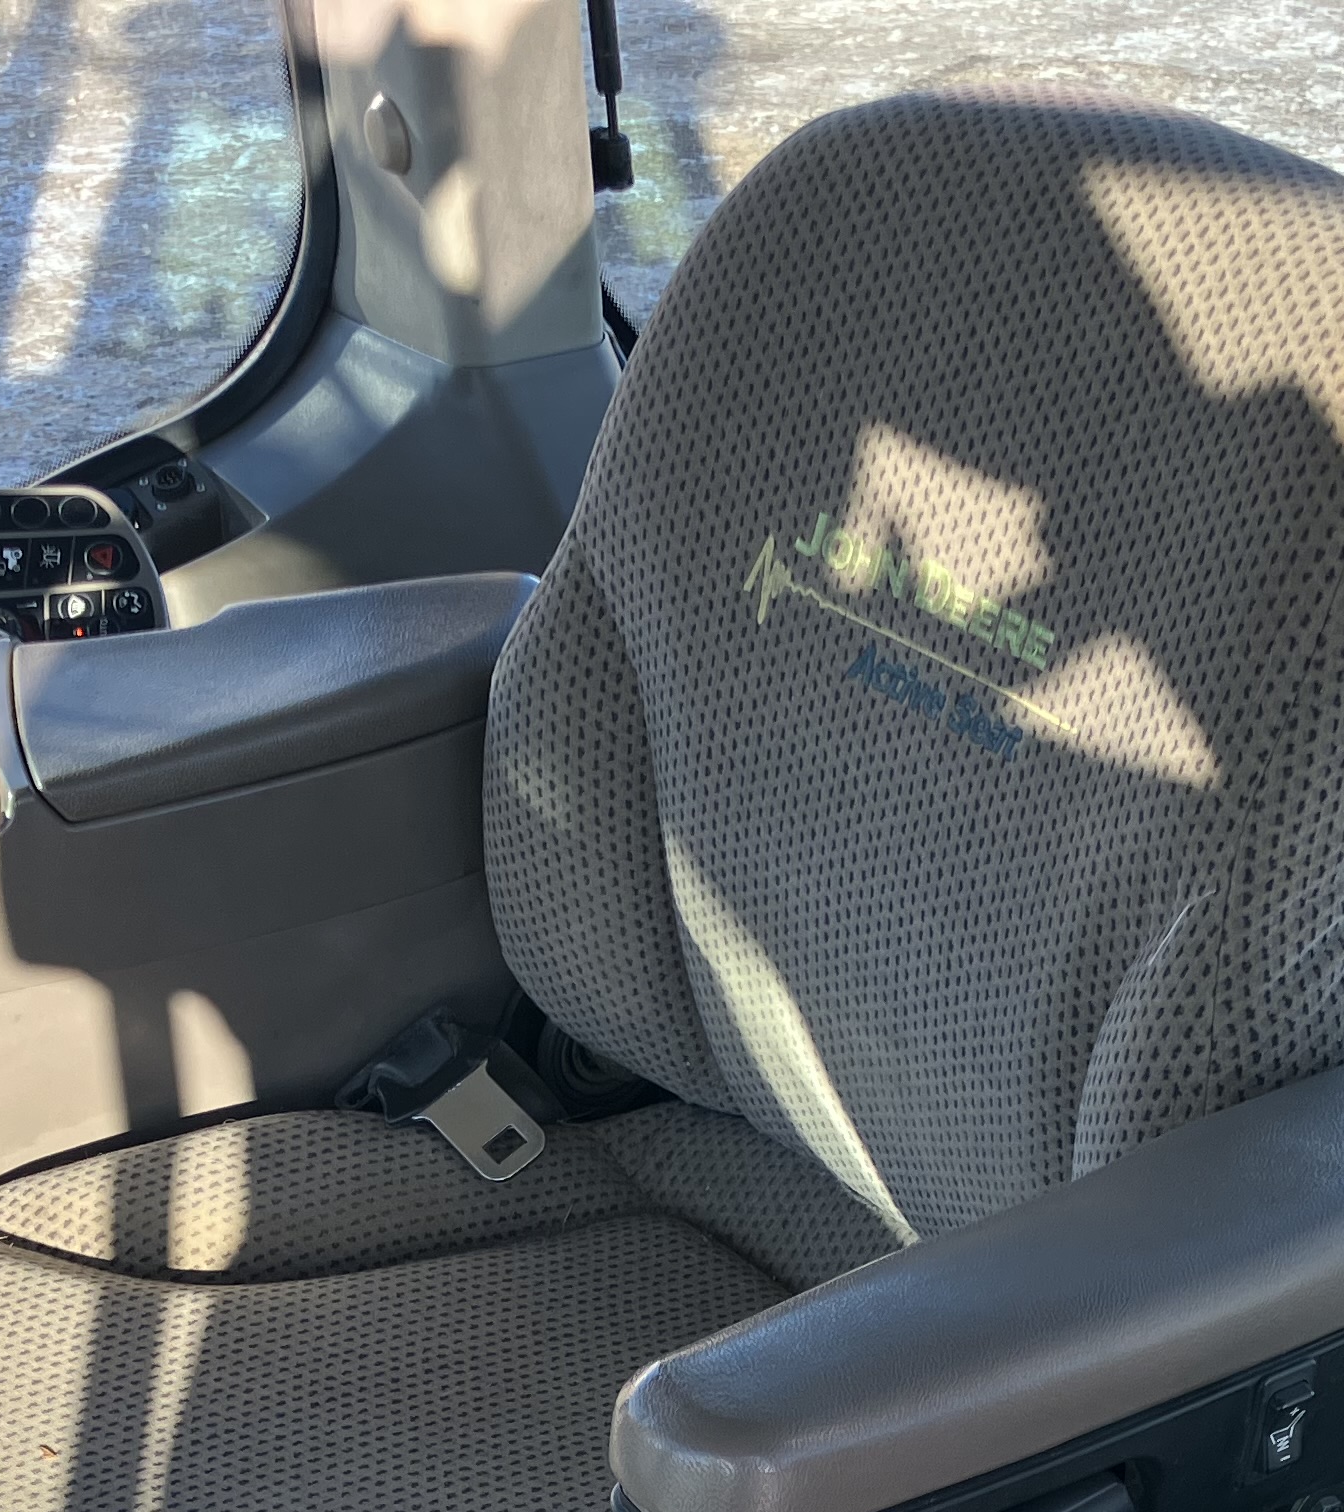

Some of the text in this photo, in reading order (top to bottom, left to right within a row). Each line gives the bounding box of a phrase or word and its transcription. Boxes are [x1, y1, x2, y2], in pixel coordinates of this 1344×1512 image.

[794, 511, 1056, 671] JOHN DEERE
[846, 645, 1023, 762] Active Seat
